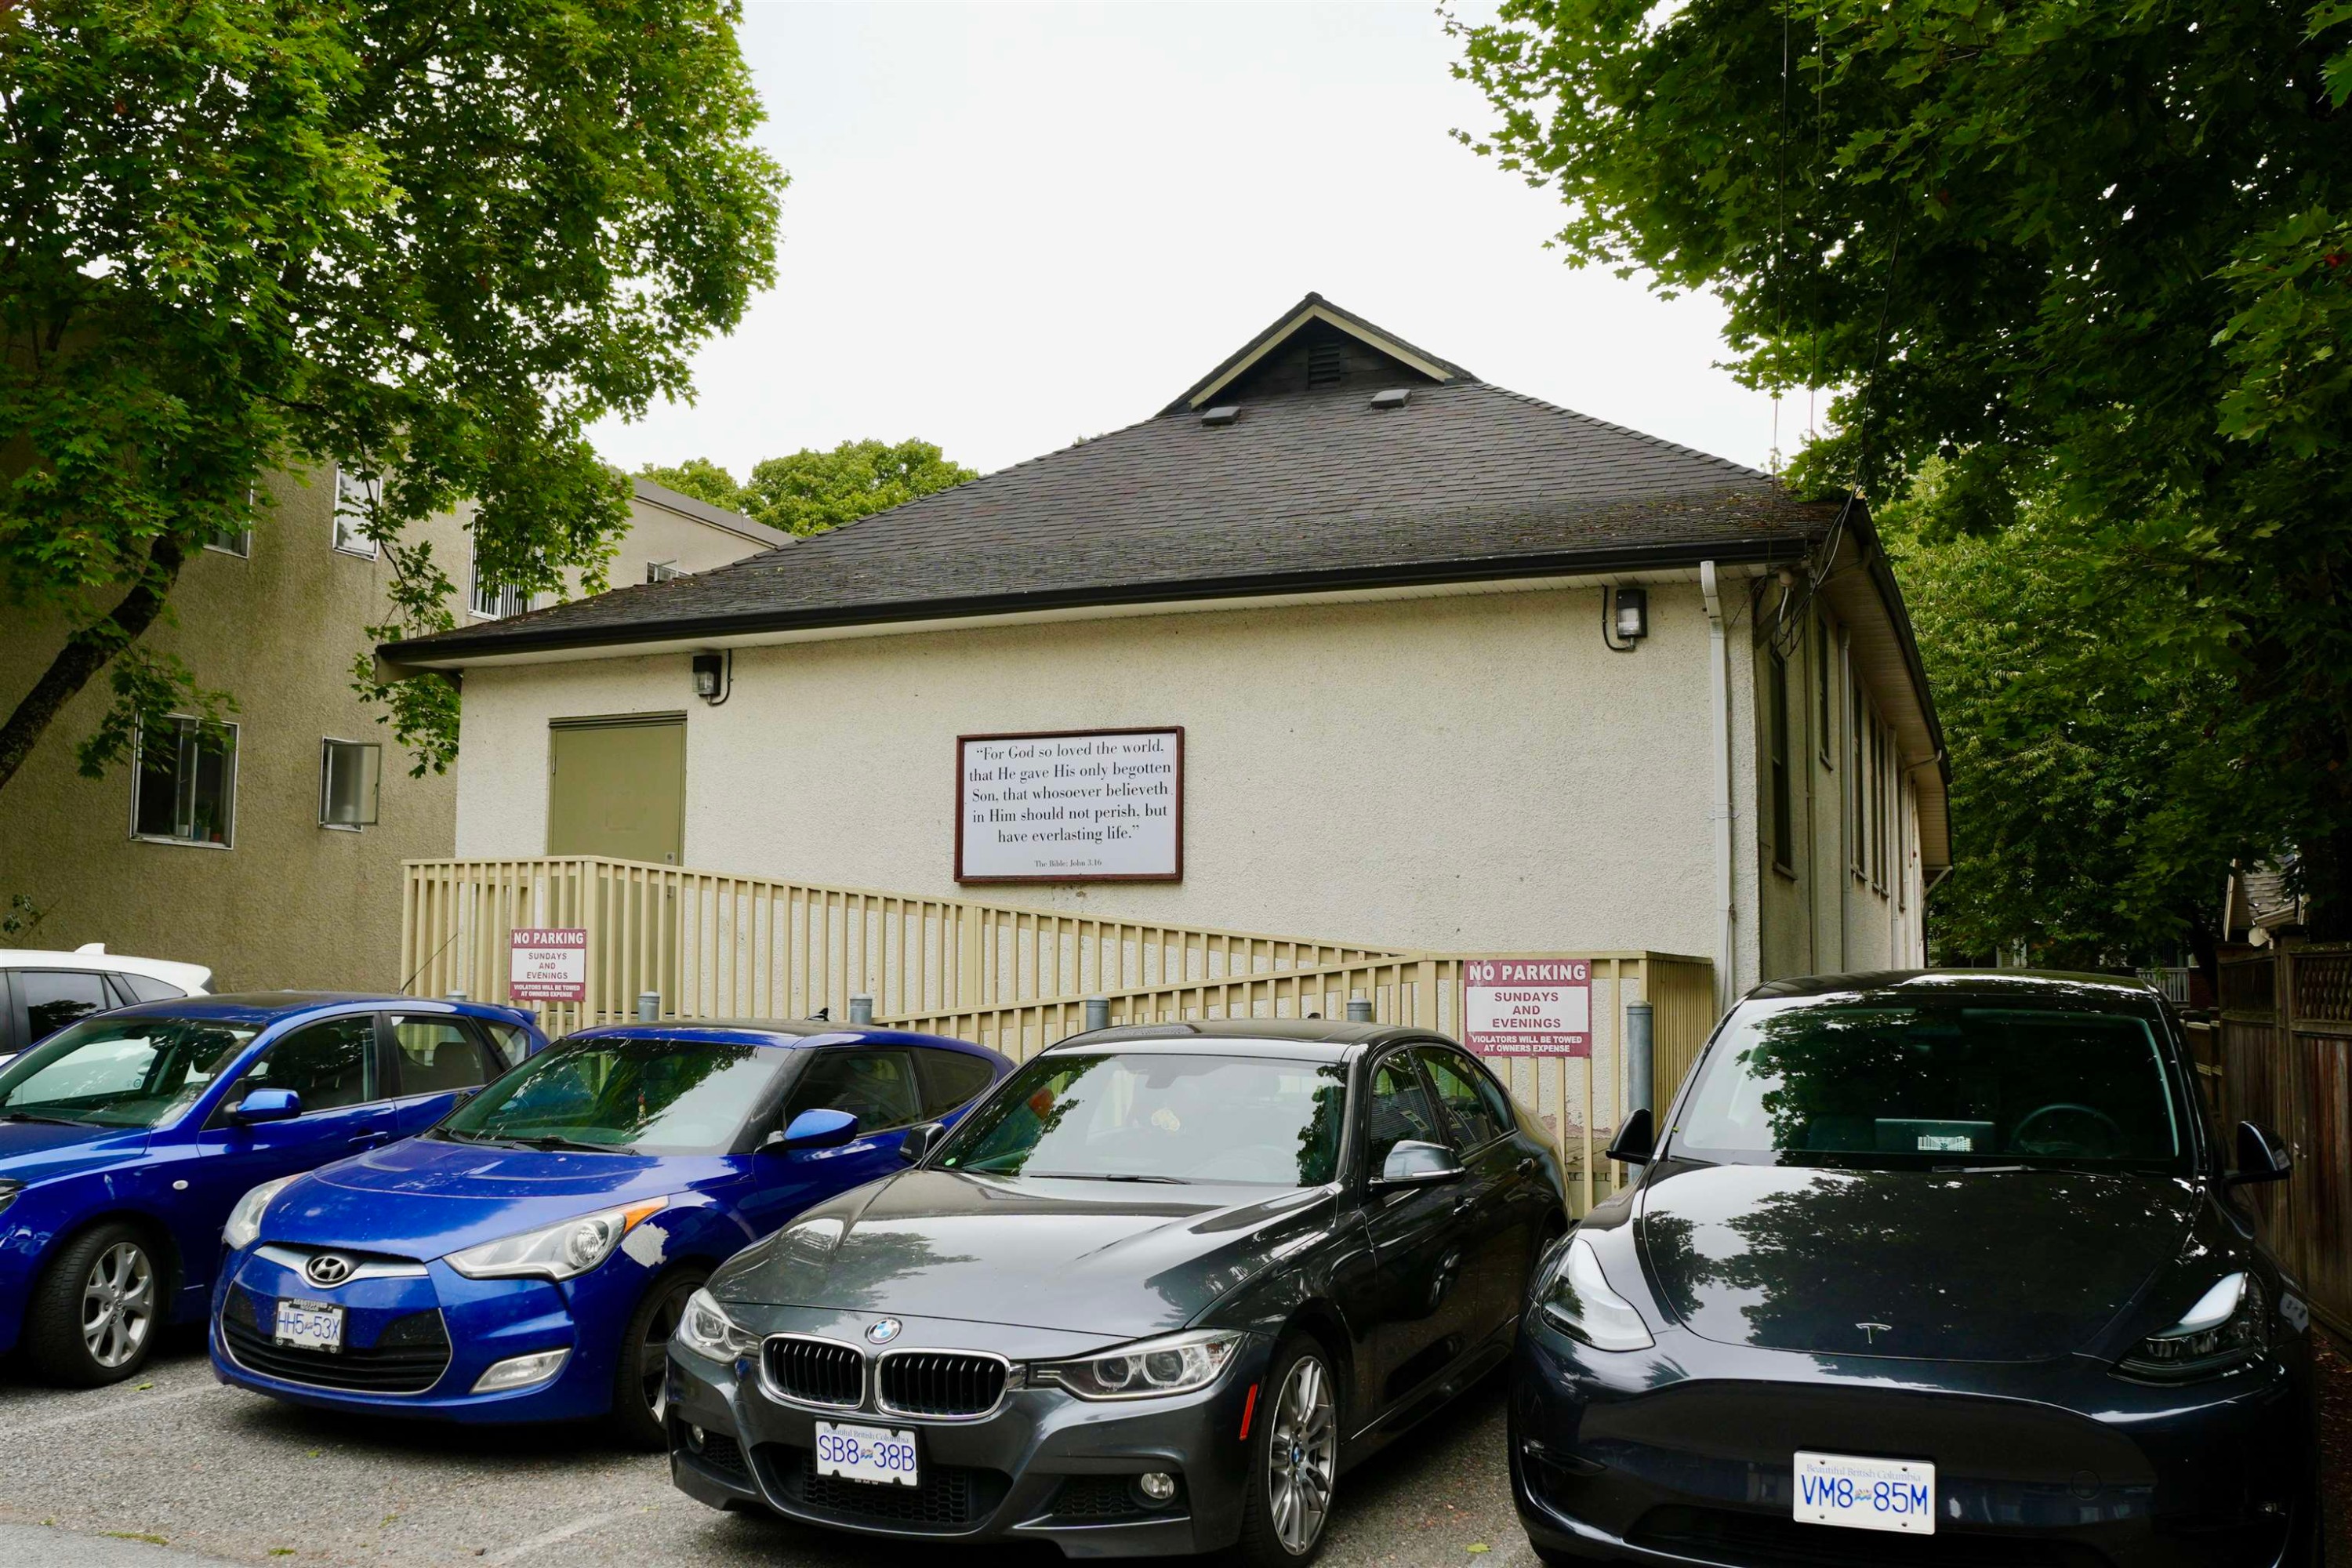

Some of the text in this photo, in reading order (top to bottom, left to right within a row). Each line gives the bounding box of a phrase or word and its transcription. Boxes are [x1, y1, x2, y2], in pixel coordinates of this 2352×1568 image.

[1008, 745, 1034, 759] God
[1039, 748, 1052, 757] so
[1058, 742, 1091, 757] loved
[1097, 742, 1117, 755] the
[970, 762, 1171, 784] that He gave His only begotten
[972, 782, 1168, 802] Son, that whosoever believeth
[973, 804, 1167, 822] in Him should not perish, but
[998, 829, 1027, 843] have
[1033, 827, 1102, 844] everlasting
[514, 933, 583, 944] NO PARKING
[1470, 964, 1586, 980] NO PARKING
[1494, 993, 1559, 1001] SUNDAYS
[1513, 1006, 1540, 1014] AND
[1493, 1019, 1560, 1028] EVENINGS
[819, 1435, 915, 1471] SB8 38B
[1806, 1464, 1921, 1482] Beautiful British Columbia
[1802, 1474, 1927, 1515] VM8 85M
